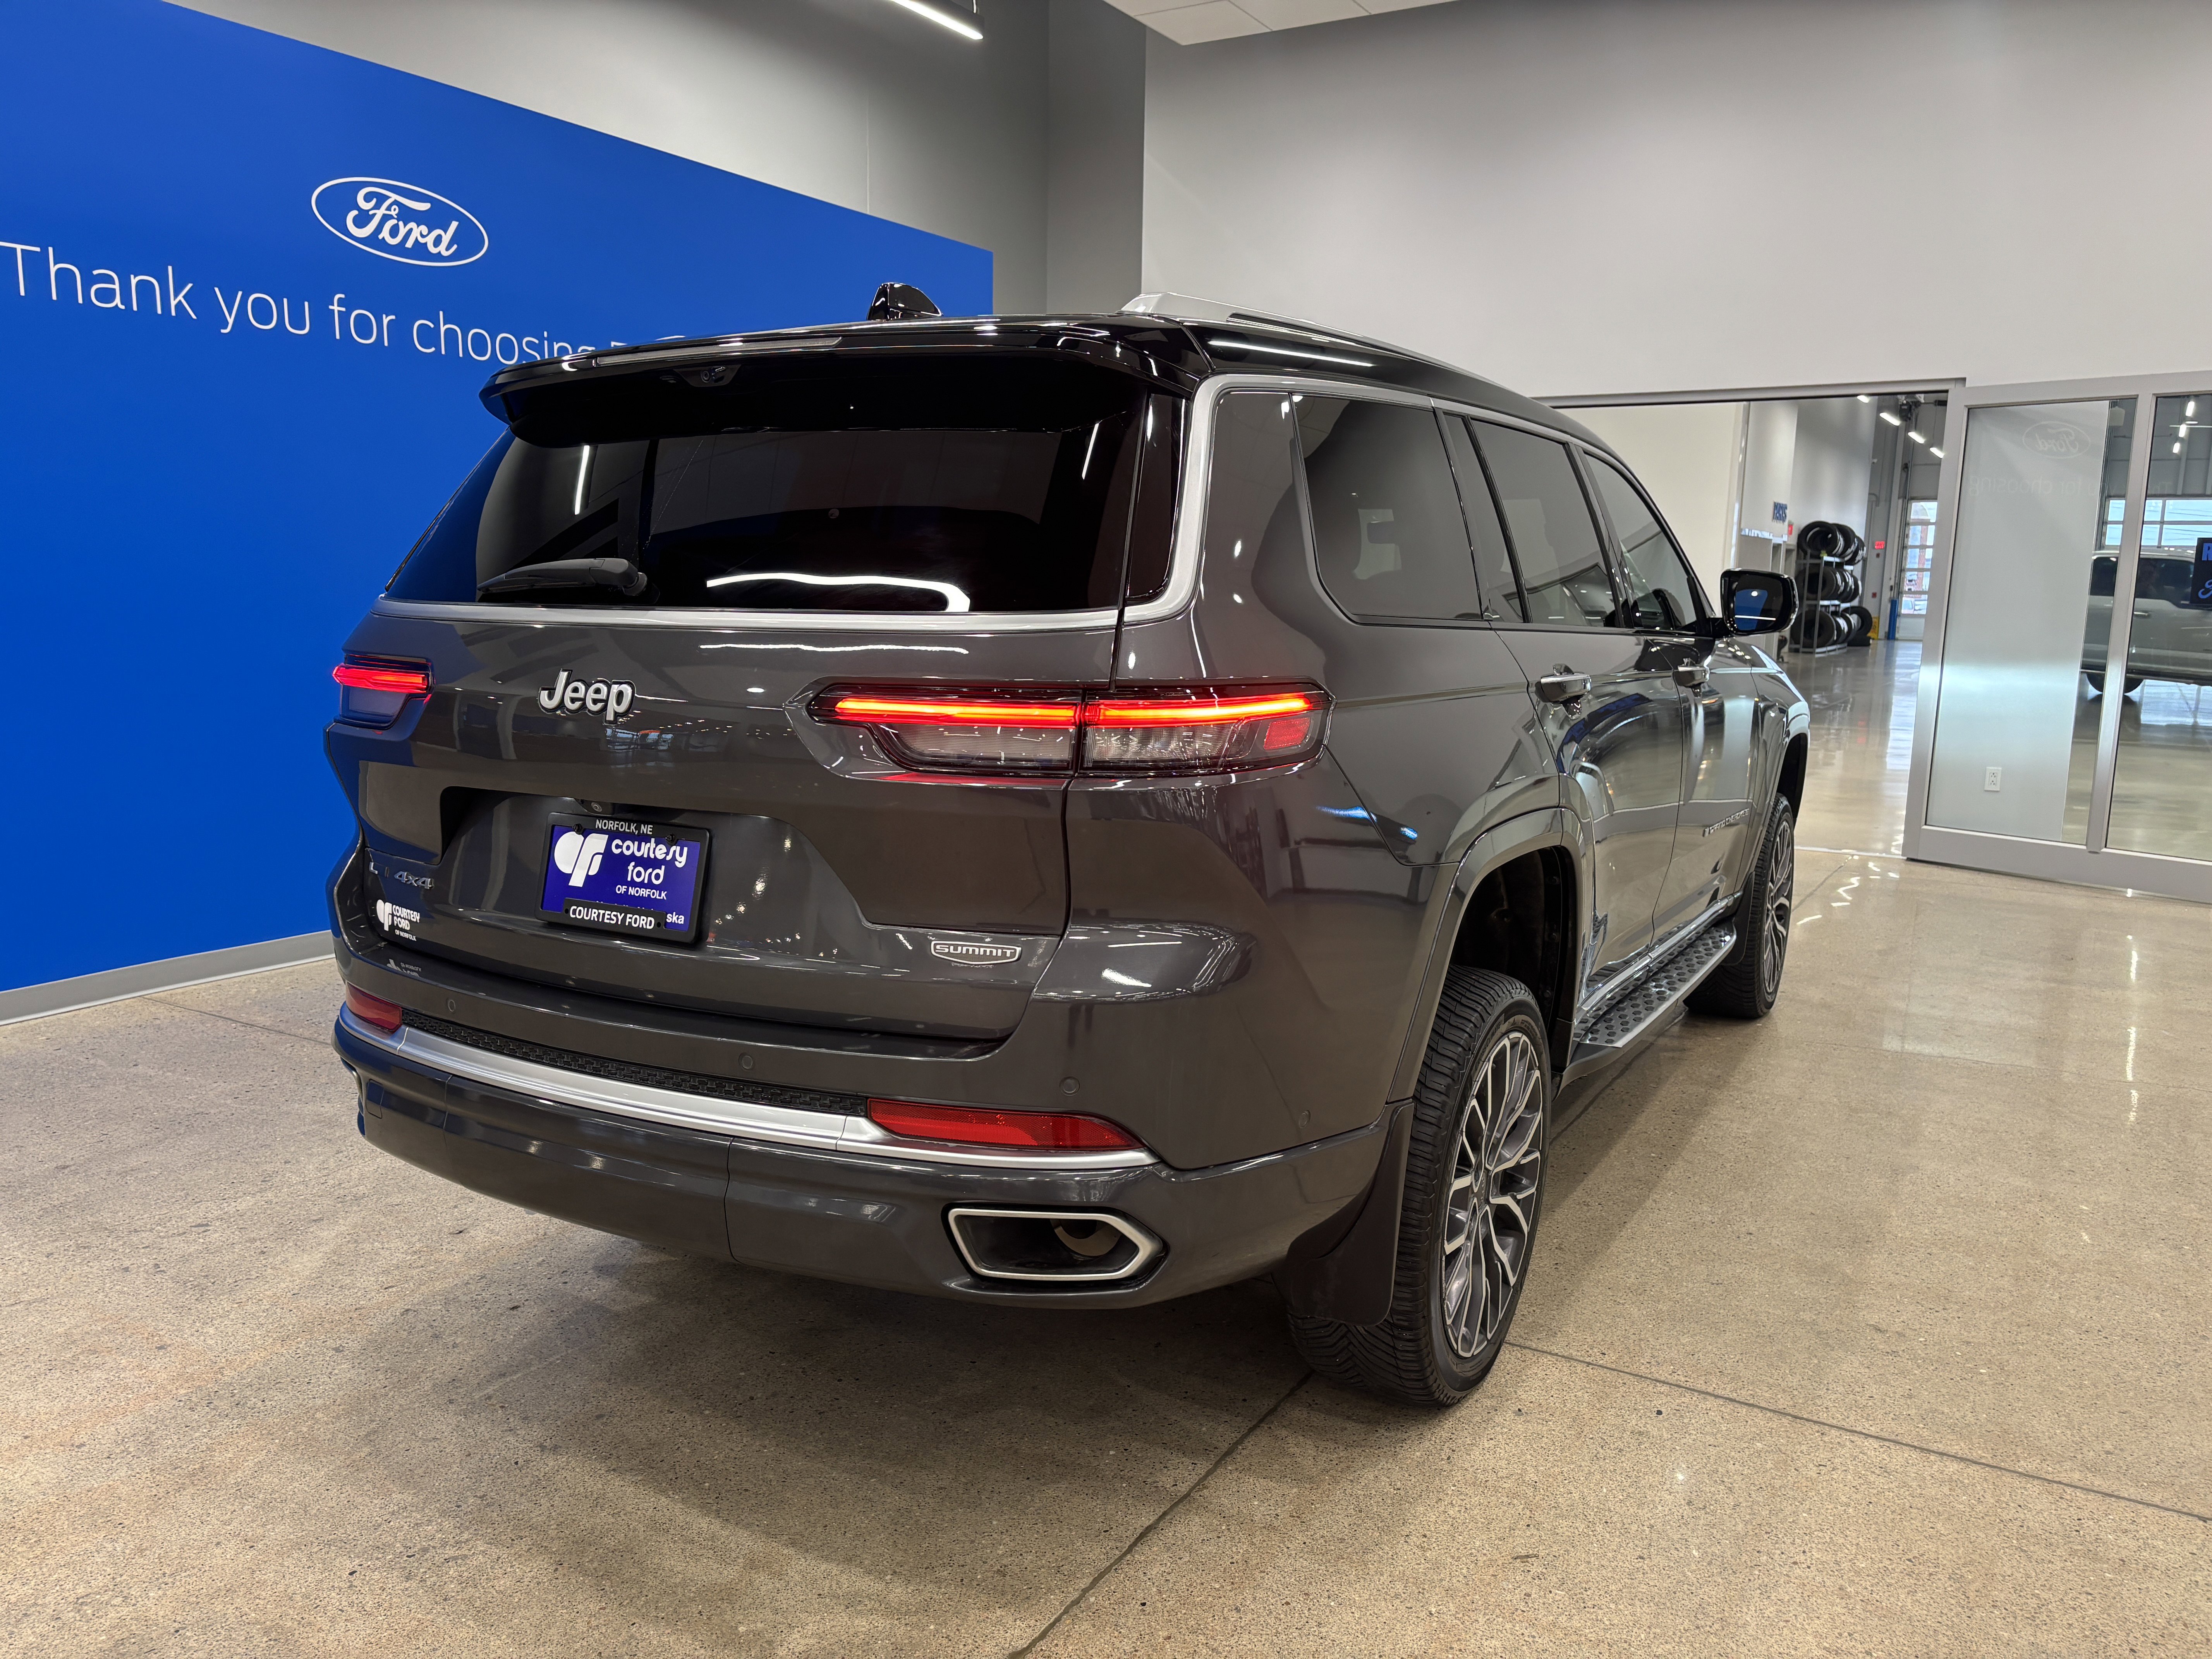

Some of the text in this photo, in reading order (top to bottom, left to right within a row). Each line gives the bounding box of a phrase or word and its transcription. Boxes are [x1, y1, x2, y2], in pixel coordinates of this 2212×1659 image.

[346, 187, 459, 256] Ford
[0, 242, 596, 365] Thank you for choosin
[539, 670, 634, 721] Jeep
[596, 819, 653, 835] NORFOLK, NE
[611, 838, 688, 868] courtesy
[394, 871, 433, 889] 4x4
[627, 862, 665, 884] ford
[616, 885, 667, 900] OF NORFOLK
[392, 905, 420, 923] COURTESY
[393, 916, 410, 930] FORD
[570, 906, 655, 929] COURTESY FORD
[935, 945, 1015, 957] SUMMIT
